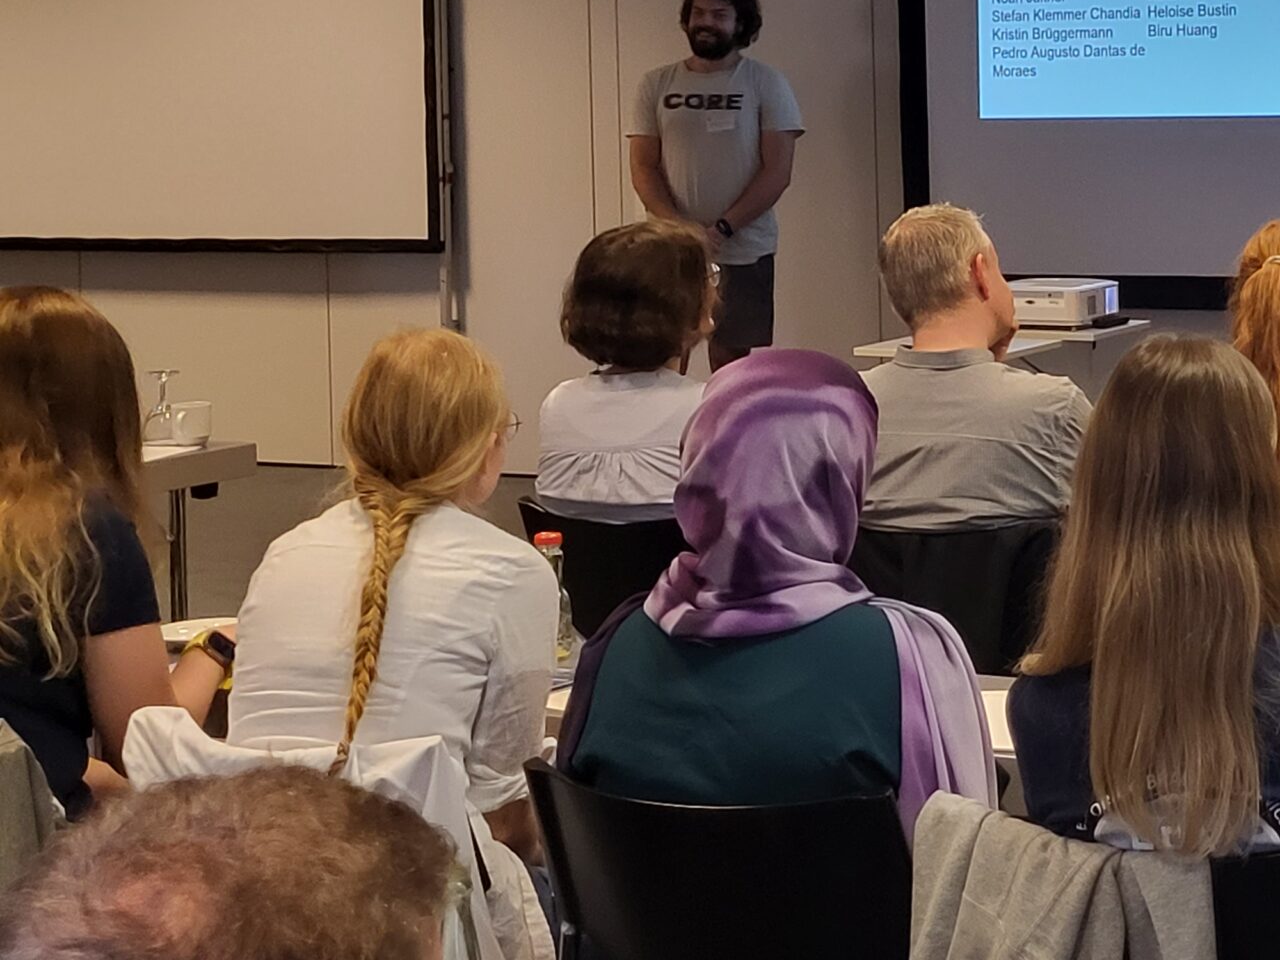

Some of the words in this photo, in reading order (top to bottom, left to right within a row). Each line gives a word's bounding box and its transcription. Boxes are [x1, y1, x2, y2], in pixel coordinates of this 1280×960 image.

[992, 9, 1030, 23] Stefan
[1033, 8, 1087, 21] Klemmer
[1090, 6, 1141, 20] Chandia
[1147, 4, 1194, 19] Heloise
[1197, 3, 1237, 17] Bustin
[992, 28, 1029, 41] Kristin
[1032, 27, 1113, 42] Brüggermann
[1148, 24, 1173, 37] Biru
[1176, 24, 1218, 39] Huang
[992, 45, 1028, 59] Pedro
[1030, 45, 1080, 61] Augusto
[1083, 44, 1127, 58] Dantas
[1129, 43, 1146, 57] de
[992, 64, 1037, 78] Moraes
